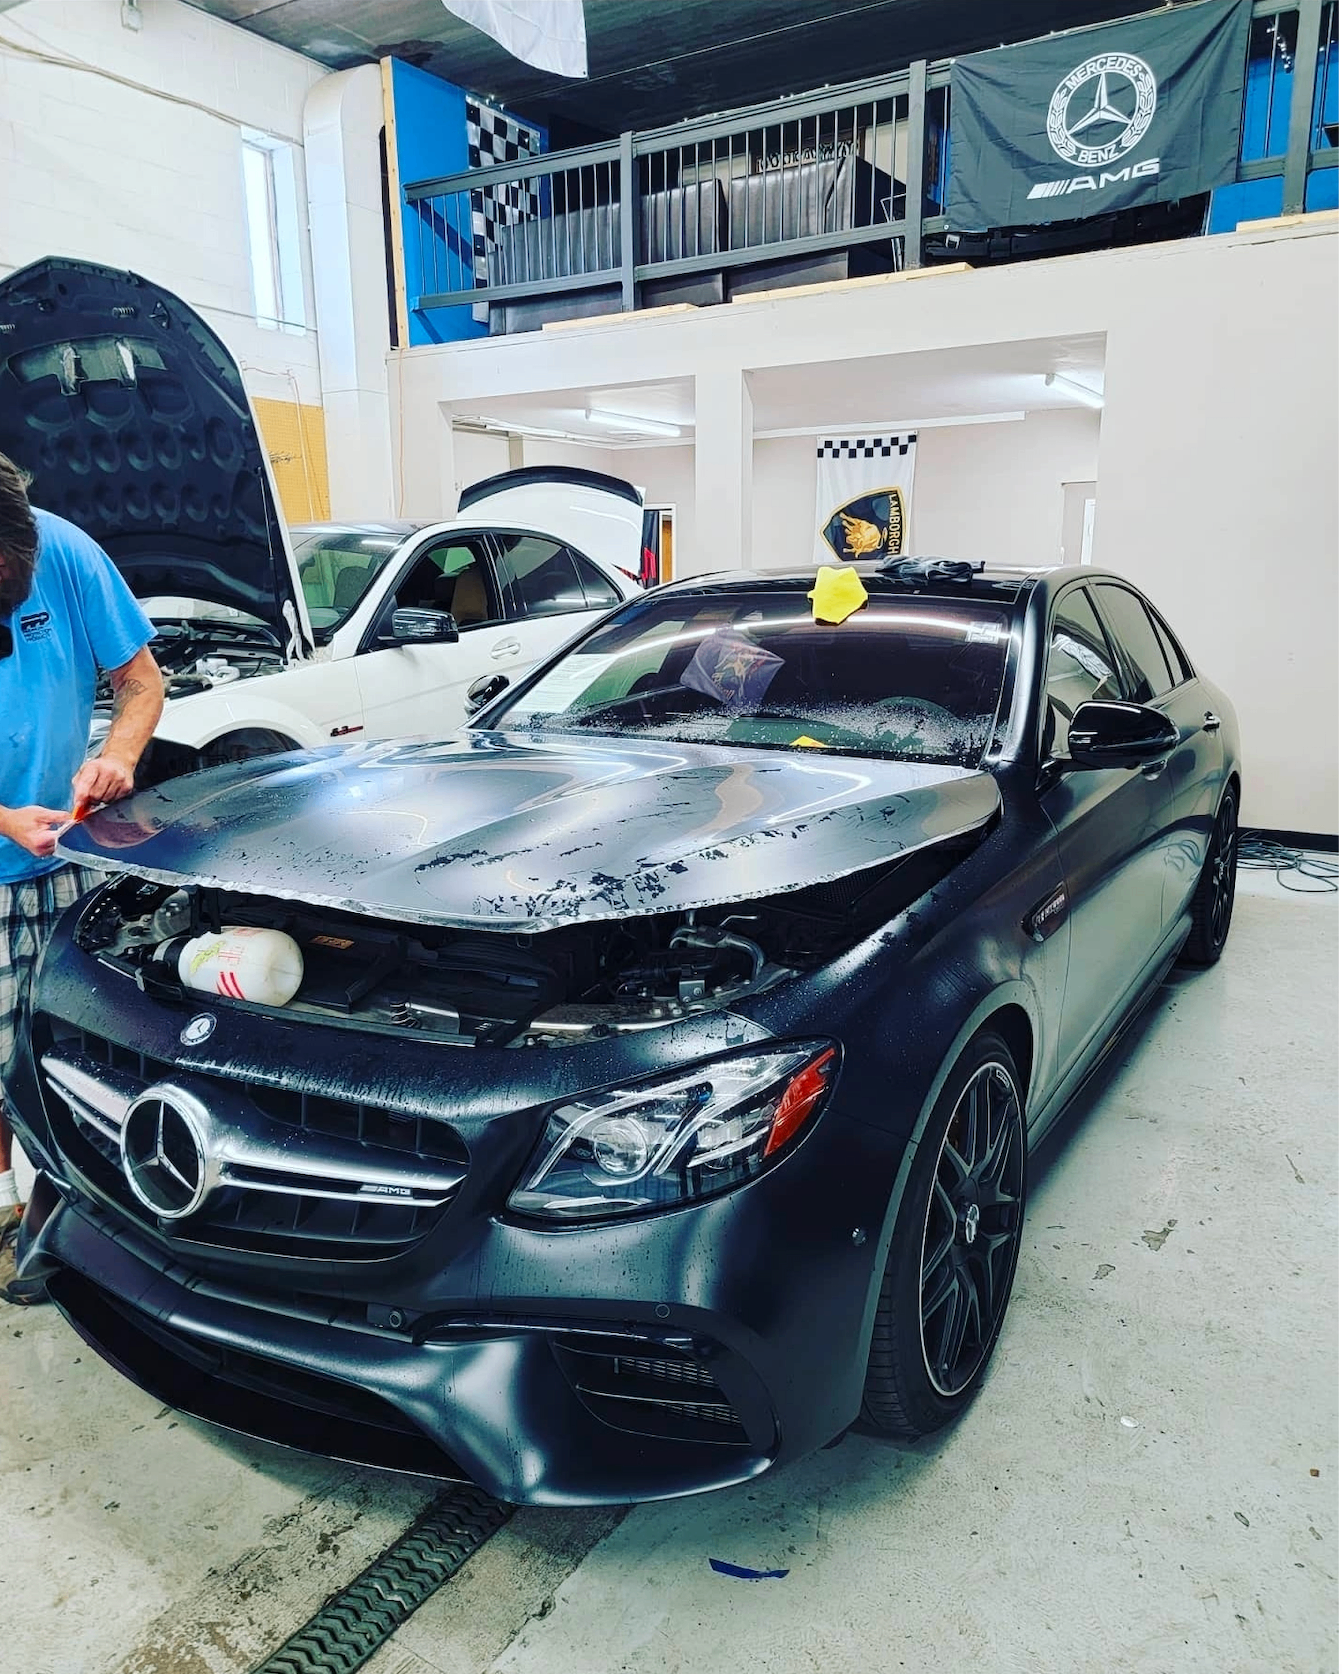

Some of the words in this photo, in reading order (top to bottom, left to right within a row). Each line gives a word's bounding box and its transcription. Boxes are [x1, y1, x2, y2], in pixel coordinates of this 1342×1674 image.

[1066, 56, 1142, 91] MERCEDES
[1077, 143, 1120, 163] BENZ
[1066, 158, 1160, 194] AMG
[887, 493, 900, 555] LAMBORGH
